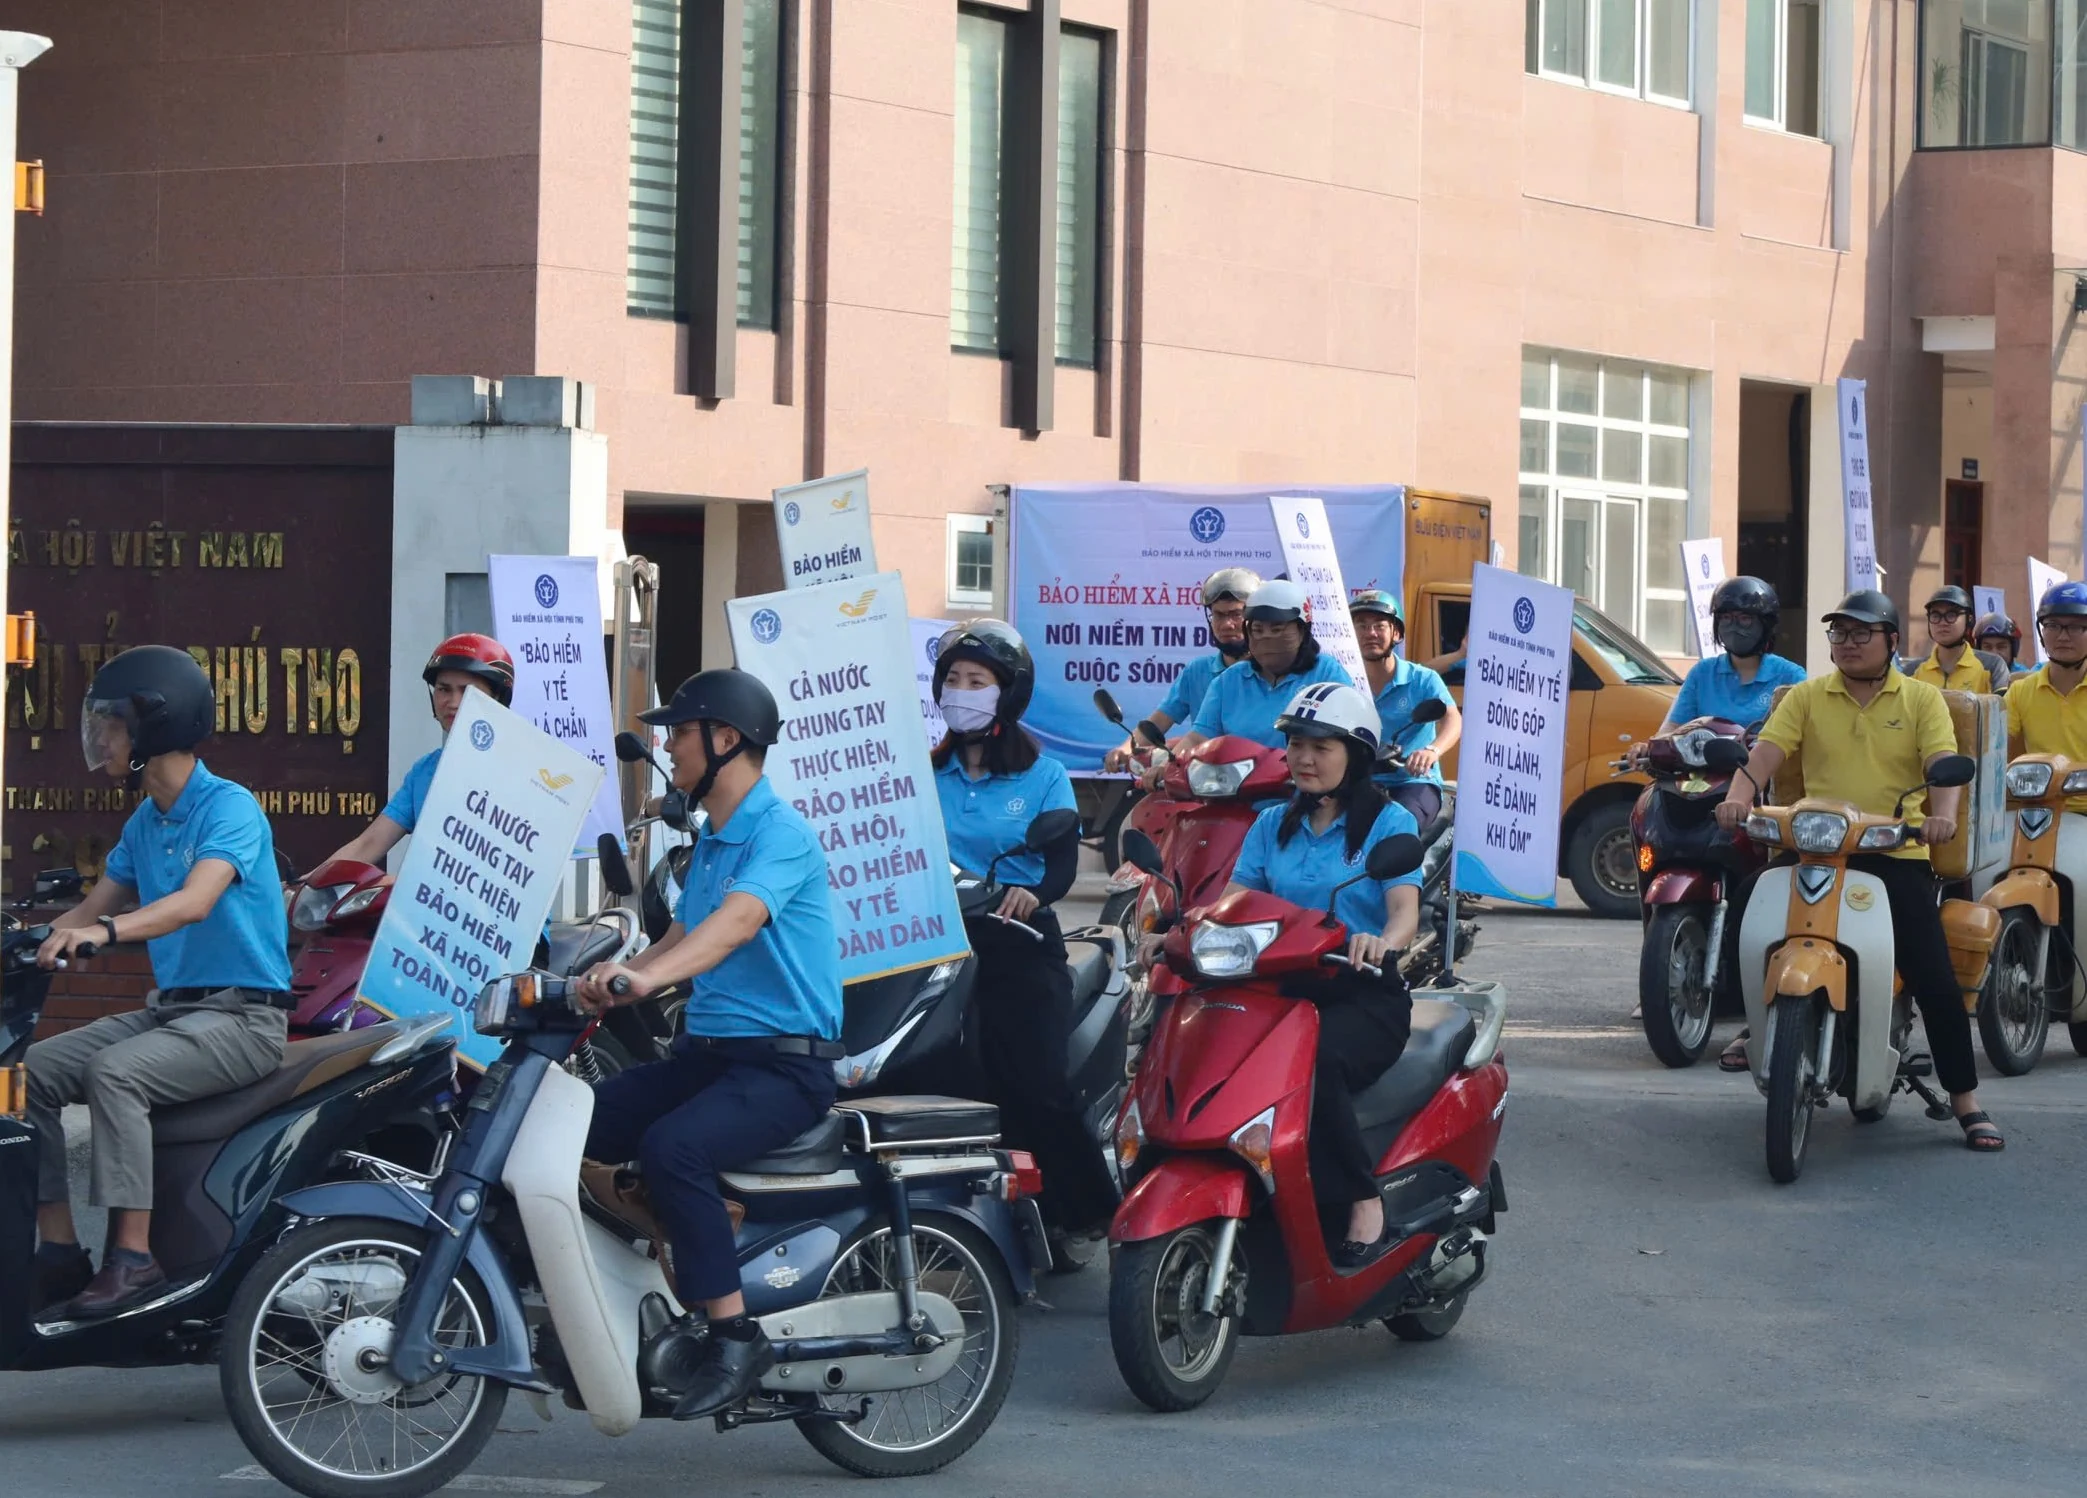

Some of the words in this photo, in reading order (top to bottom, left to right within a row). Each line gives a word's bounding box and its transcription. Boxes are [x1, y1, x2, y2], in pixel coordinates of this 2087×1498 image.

[9, 518, 28, 565] Ã
[40, 518, 96, 575] HỘI
[110, 520, 187, 576] VIỆT
[200, 531, 284, 568] NAM
[793, 553, 822, 576] BẢO
[825, 543, 862, 569] HIỂM
[1142, 549, 1159, 557] BẢO
[1161, 547, 1181, 557] HIỂM
[1184, 549, 1195, 557] XÃ
[1197, 549, 1212, 559] HỘI
[1213, 548, 1232, 558] TỈNH
[1235, 549, 1252, 558] PHÚ
[1255, 551, 1272, 559] THỌ
[1039, 577, 1079, 604] BẢO
[1083, 573, 1138, 605] HIỂM
[1142, 582, 1171, 606] XÃ
[1176, 581, 1203, 610] HỘ
[553, 633, 582, 664] HIỂM
[1046, 622, 1081, 645] NƠI
[1088, 618, 1144, 646] NIỀM
[1151, 626, 1186, 647] TIN
[543, 680, 550, 700] Y
[552, 669, 568, 701] TẾ
[789, 668, 814, 702] CẢ
[817, 663, 871, 697] NƯỚC
[1064, 657, 1120, 686] CUỘC
[1507, 659, 1535, 695] HIỂM
[1539, 675, 1545, 698] Y
[1547, 669, 1561, 703] TẾ
[280, 647, 361, 754] THỌ
[1487, 698, 1519, 731] ĐÓNG
[1522, 707, 1545, 737] GÓP
[554, 706, 587, 738] CHẮN
[786, 709, 851, 742] CHUNG
[854, 700, 887, 727] TAY
[790, 750, 842, 781] THỰC
[845, 738, 896, 772] HIỆN,
[1485, 741, 1504, 767] KHI
[1507, 743, 1541, 781] LÀNH,
[6, 781, 77, 811] THÀNH
[288, 786, 330, 815] PHÚ
[337, 792, 376, 822] THỌ
[792, 787, 846, 820] BẢO
[851, 771, 916, 810] HIỂM
[1485, 773, 1502, 807] ĐỂ
[1504, 782, 1537, 816] DÀNH
[466, 790, 488, 820] CẢ
[489, 805, 540, 853] NƯỚC
[851, 813, 906, 847] HỘI,
[1486, 822, 1506, 849] KHI
[443, 815, 502, 868] CHUNG
[503, 853, 535, 889] TAY
[827, 861, 858, 891] ẢO
[863, 846, 928, 883] HIỂM
[432, 846, 480, 893] THỰC
[479, 879, 521, 922] HIỆN
[847, 897, 862, 922] Y
[867, 882, 900, 918] TẾ
[415, 882, 459, 922] BẢO
[461, 912, 513, 960] HIỂM
[890, 913, 946, 949] DÂN
[419, 925, 447, 957] XÃ
[451, 945, 491, 982] HỘI
[391, 948, 449, 998] TOÀN
[451, 985, 480, 1012] DÂ
[0, 1135, 31, 1145] ONDA
